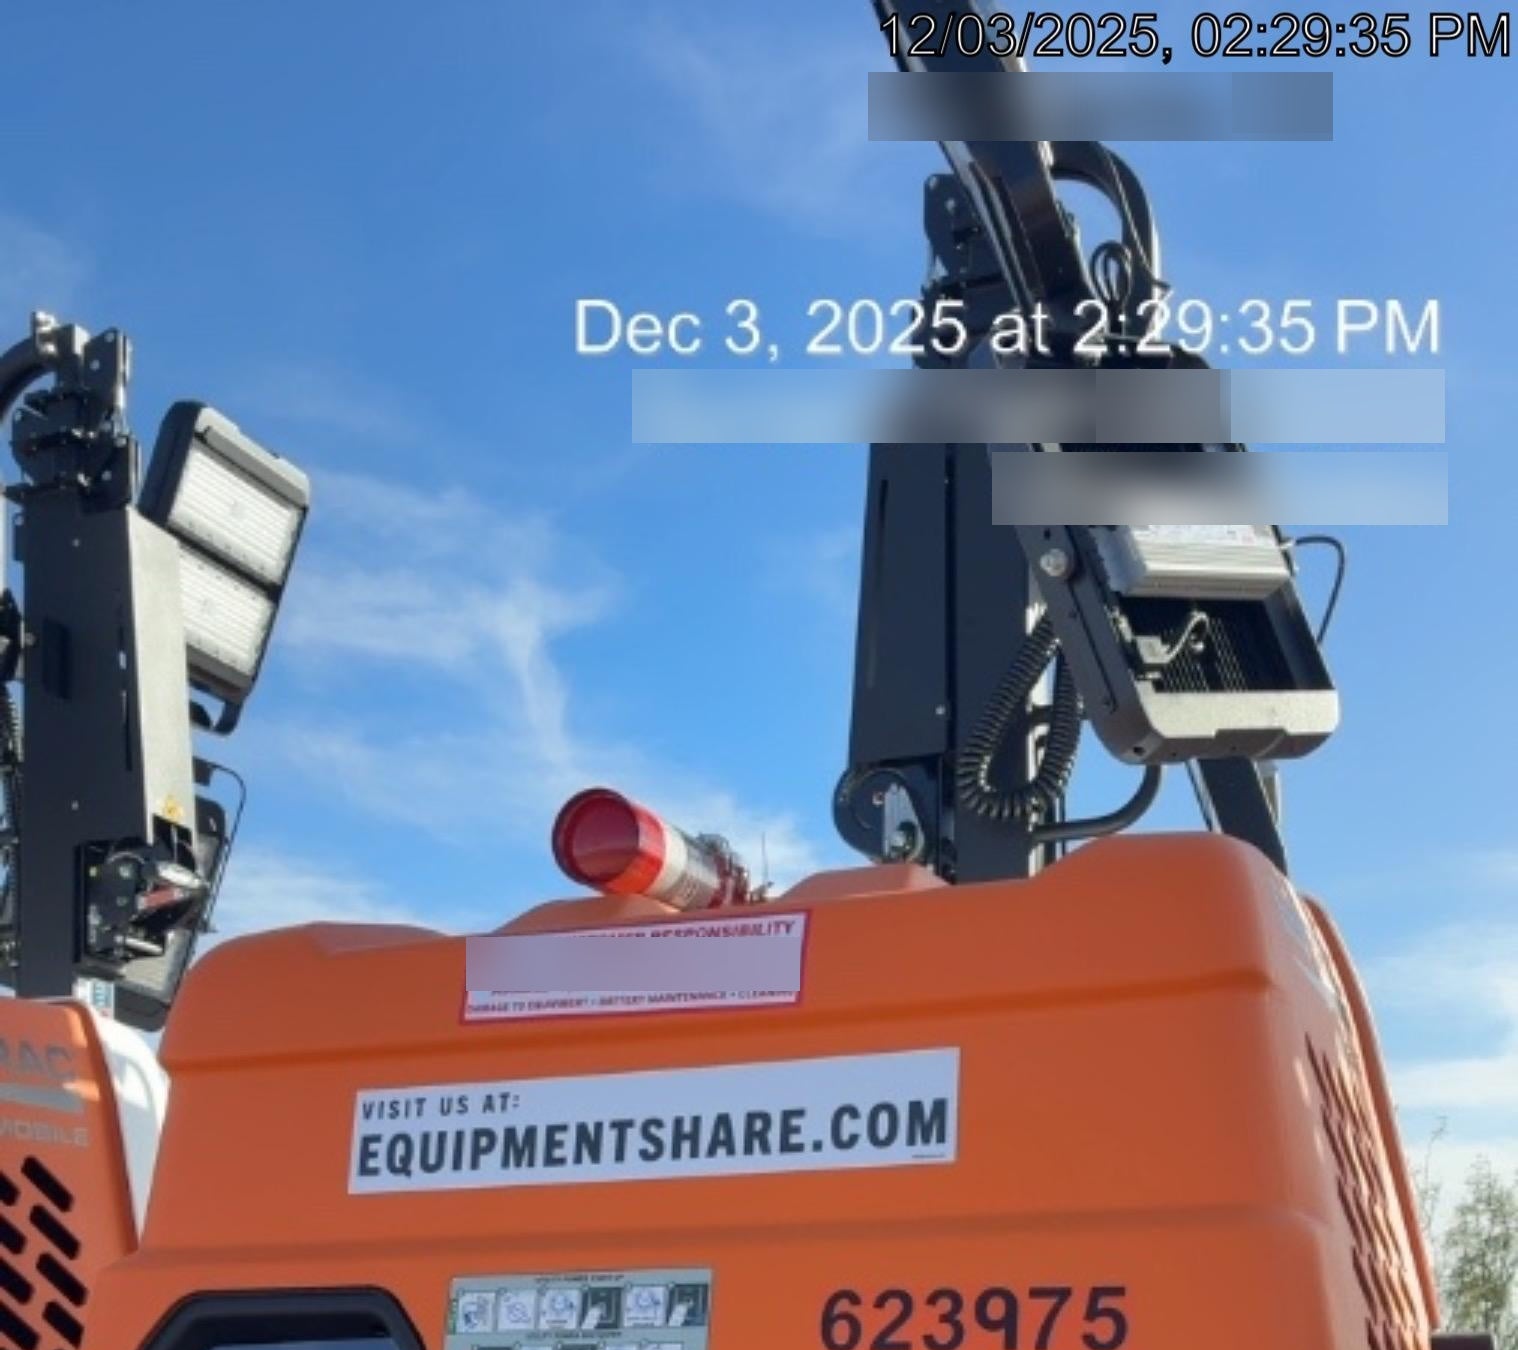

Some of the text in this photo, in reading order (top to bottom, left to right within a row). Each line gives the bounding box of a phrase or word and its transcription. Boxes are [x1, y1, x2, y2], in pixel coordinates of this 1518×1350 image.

[362, 1092, 521, 1120] VISIT US AT:
[357, 1098, 949, 1178] EQUIPMENTSHARE.COM
